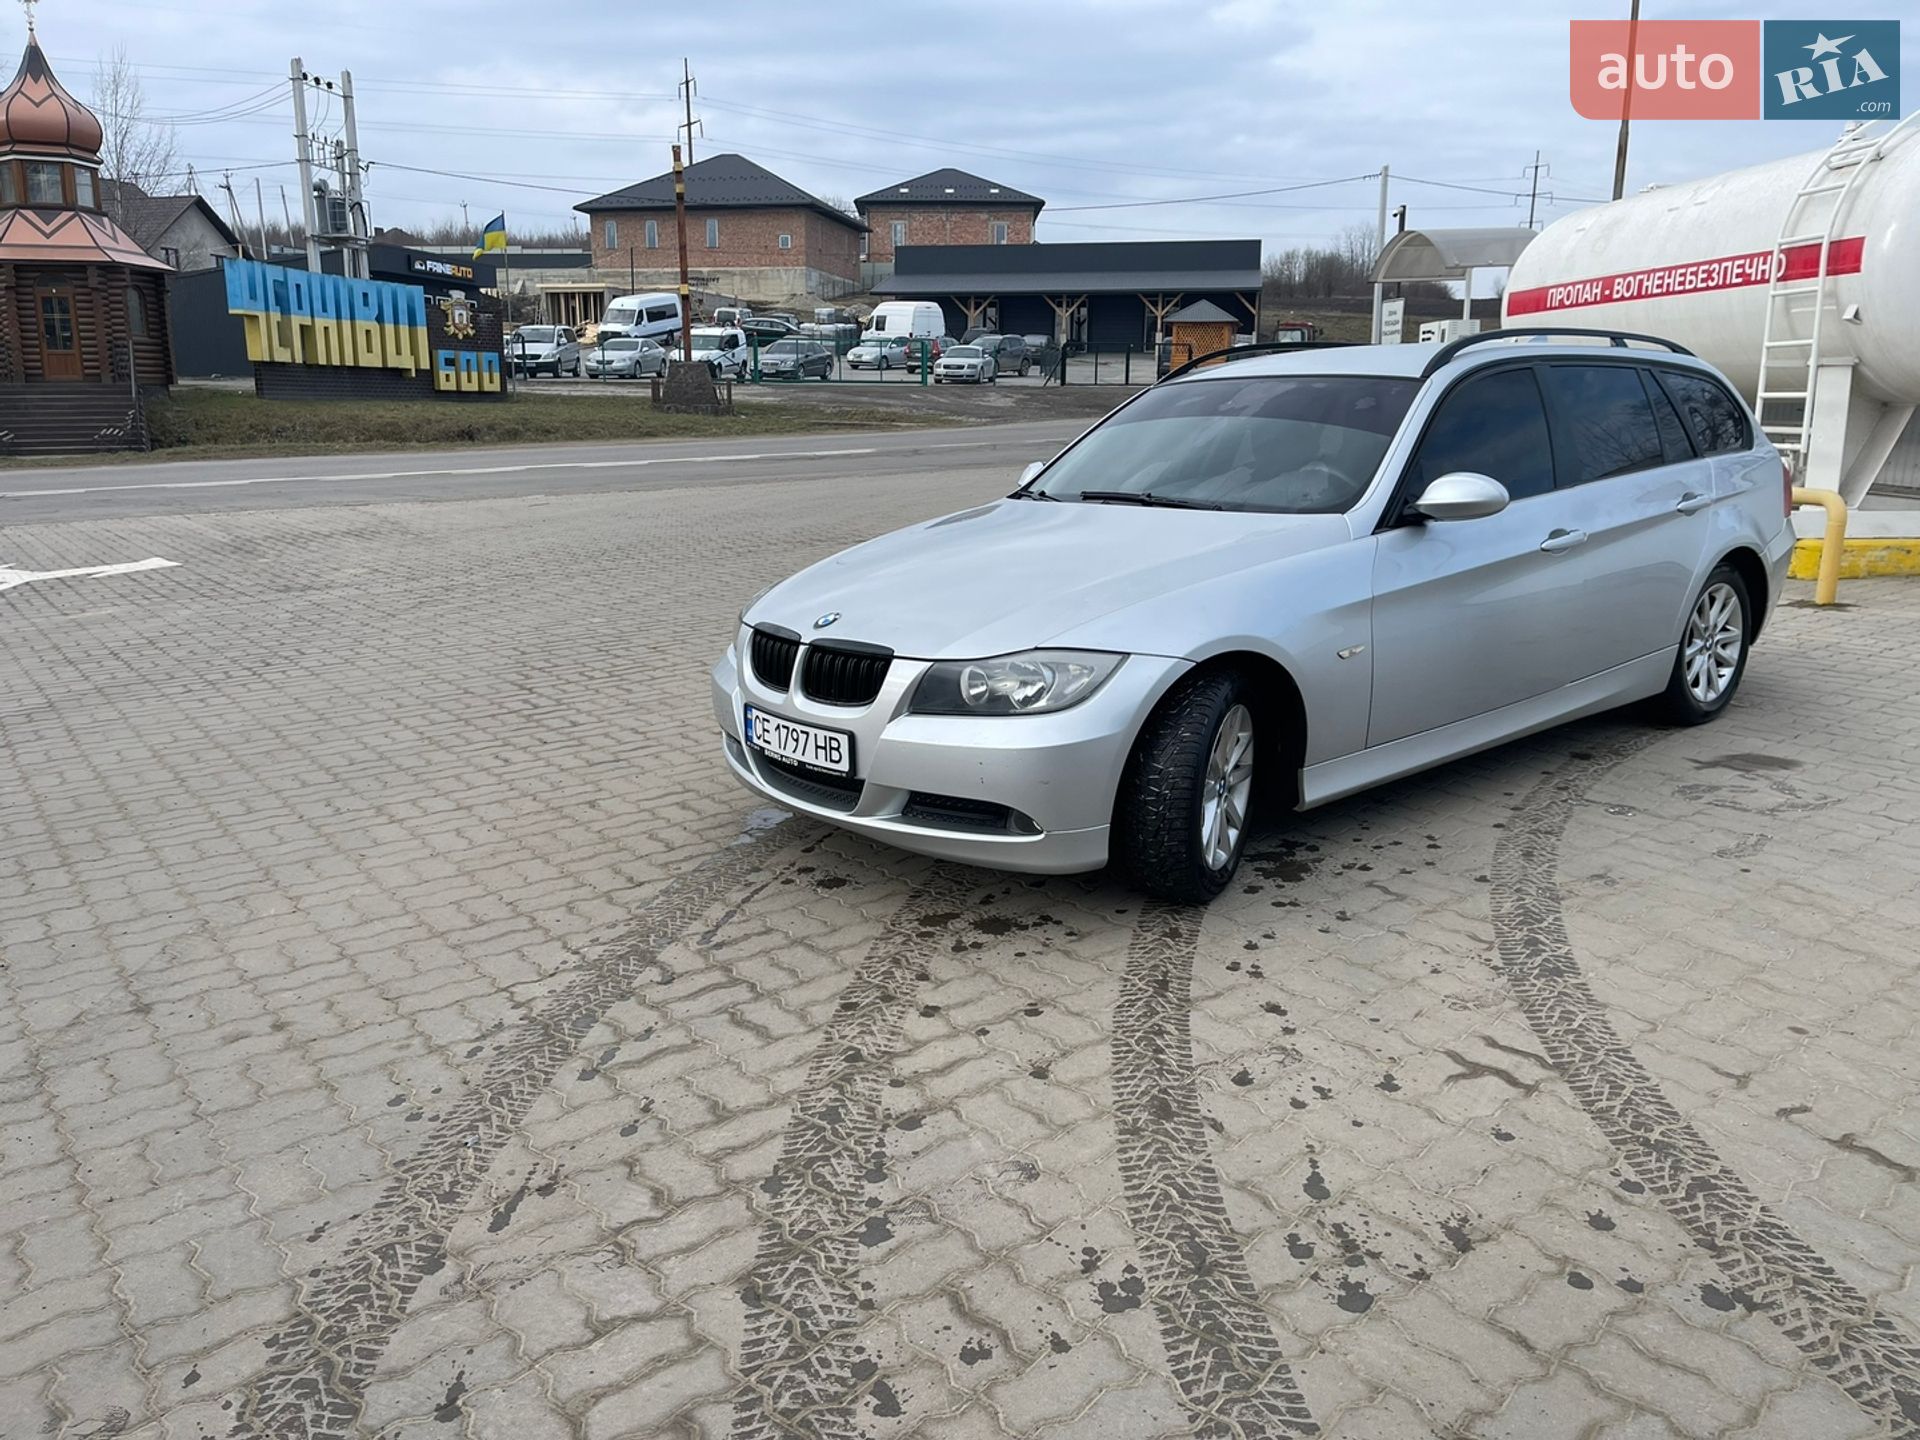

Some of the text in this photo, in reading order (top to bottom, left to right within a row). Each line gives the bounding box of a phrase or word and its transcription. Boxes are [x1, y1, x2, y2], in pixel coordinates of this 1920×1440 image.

[1546, 281, 1603, 308] ПРОПАН
[437, 349, 501, 391] 600
[753, 714, 772, 746] CE
[774, 723, 810, 757] 1797
[814, 732, 843, 764] HB
